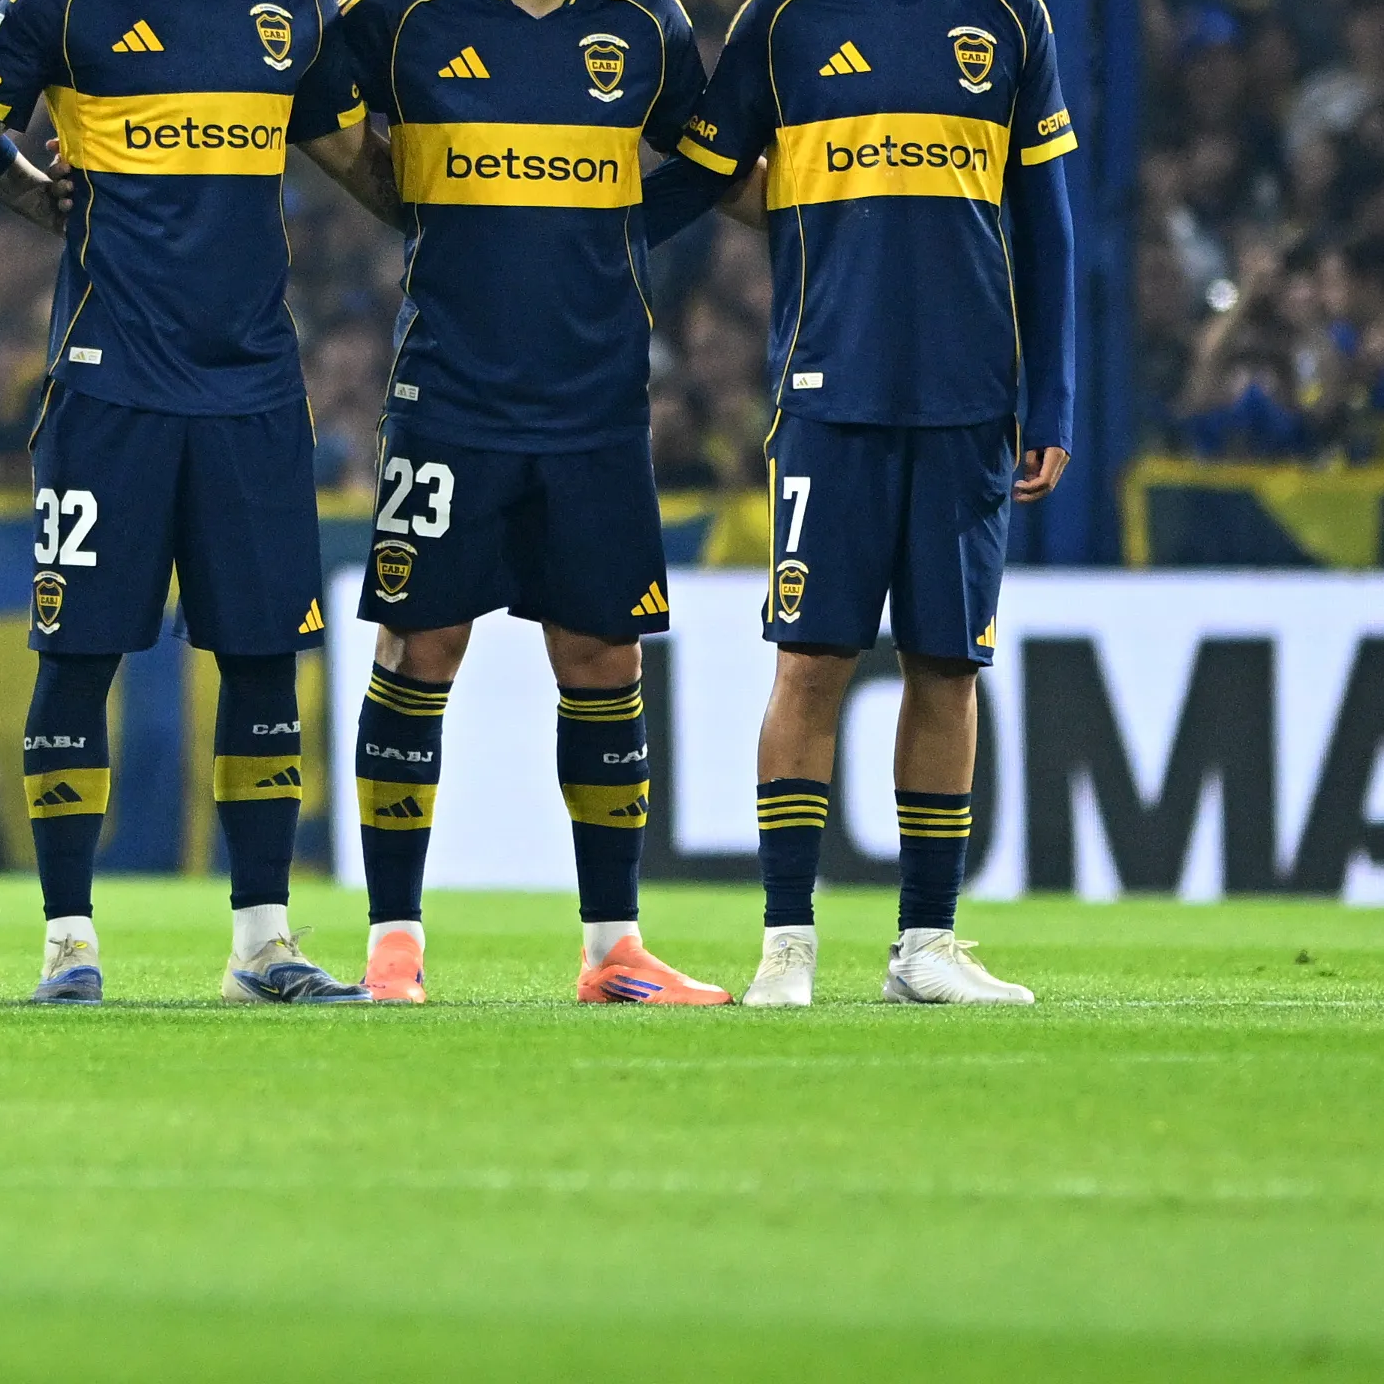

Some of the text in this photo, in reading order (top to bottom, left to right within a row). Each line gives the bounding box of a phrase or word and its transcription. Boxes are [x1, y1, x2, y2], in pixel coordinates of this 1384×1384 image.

[263, 30, 286, 41] CABJ
[592, 60, 618, 72] CABJ
[961, 51, 988, 64] CABJ
[125, 117, 283, 151] betsson
[826, 135, 988, 173] betsson
[446, 146, 619, 184] betsson
[376, 456, 455, 538] 23
[782, 477, 811, 552] 7
[34, 488, 98, 566] 32
[381, 564, 406, 575] CABJ
[783, 584, 801, 594] CABJ
[40, 595, 59, 605] CABJ
[24, 735, 87, 750] CABJ
[365, 743, 434, 763] CABJ
